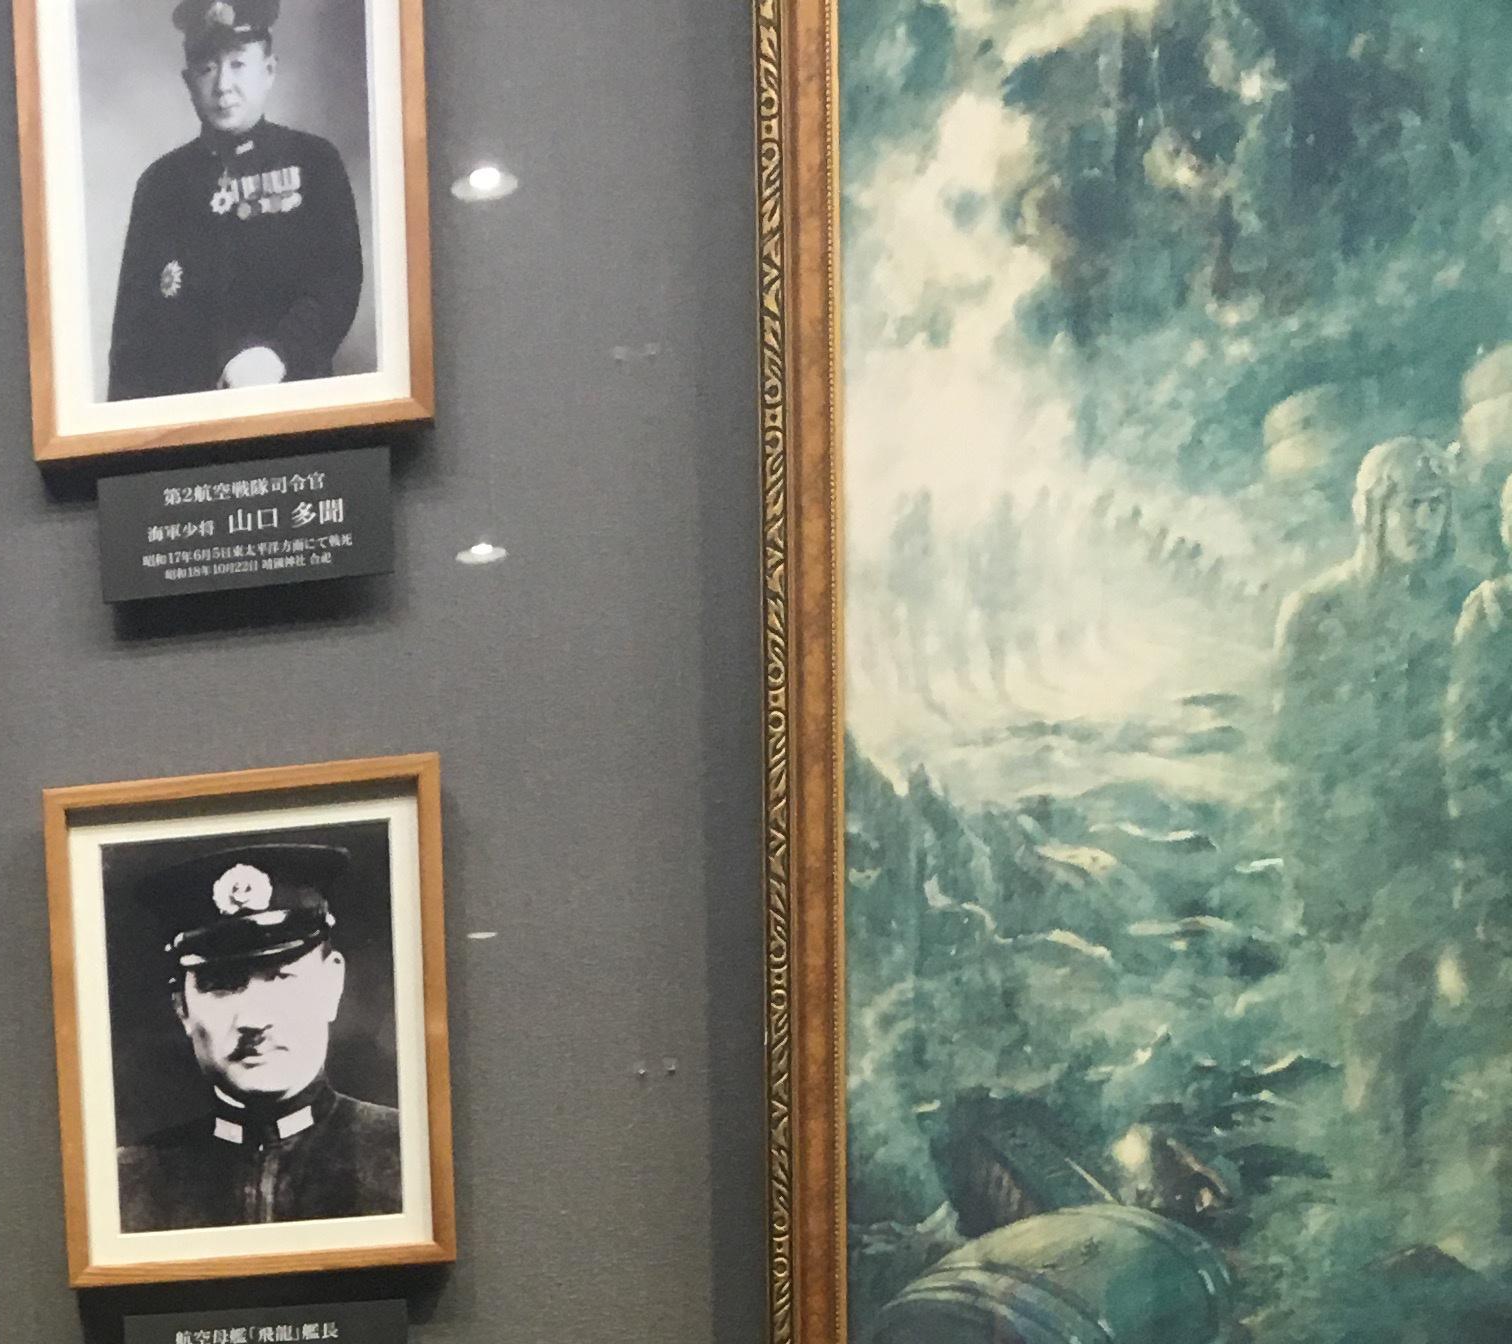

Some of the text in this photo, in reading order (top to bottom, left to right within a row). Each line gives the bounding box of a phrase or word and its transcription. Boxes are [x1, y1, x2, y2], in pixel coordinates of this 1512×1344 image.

[162, 471, 326, 506] 第2航空戦隊司令官
[147, 497, 345, 543] 海軍少将 山口 多聞
